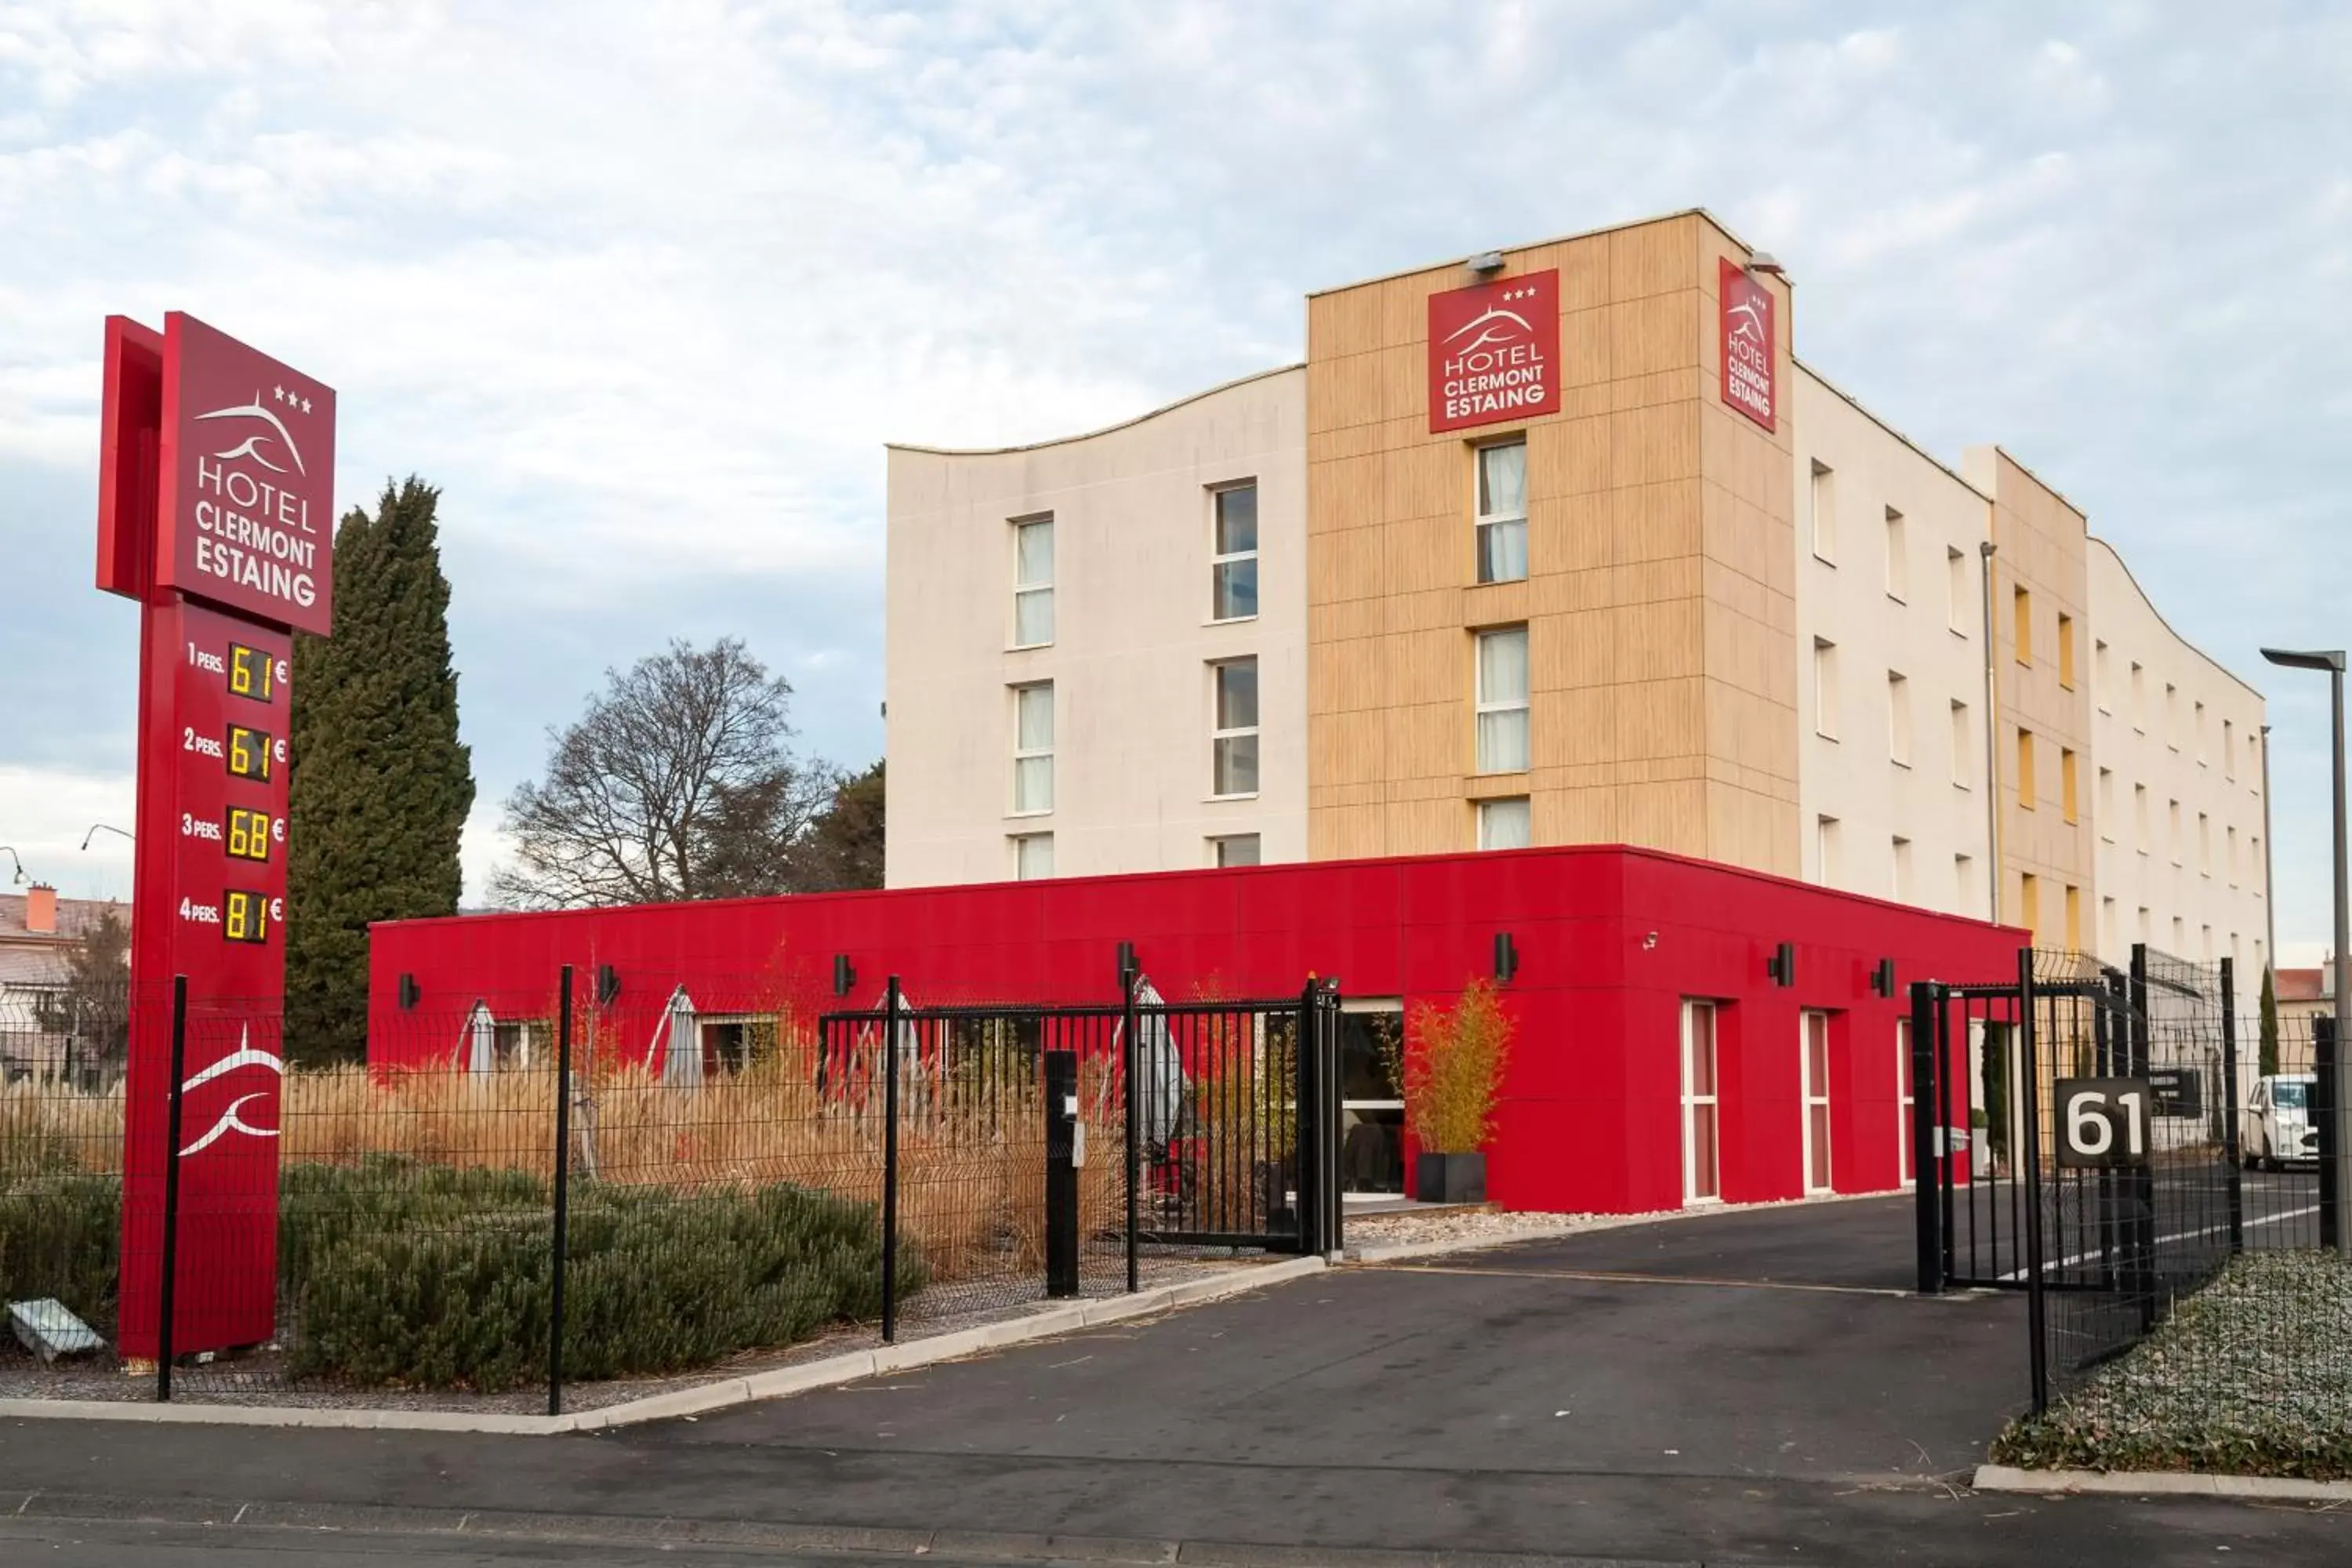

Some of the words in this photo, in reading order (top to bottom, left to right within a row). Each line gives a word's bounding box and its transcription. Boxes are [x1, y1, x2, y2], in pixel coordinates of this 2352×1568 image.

[1444, 343, 1544, 377] HOTEL
[1728, 332, 1769, 376] HOTEL
[1728, 355, 1769, 396] CLERMONT
[1443, 365, 1544, 397] CLERMONT
[1446, 384, 1545, 419] ESTAING
[1729, 375, 1770, 417] ESTAING
[198, 456, 316, 534] HOTEL
[195, 501, 316, 569] CLERMONT
[197, 535, 316, 607] ESTAING
[188, 642, 195, 665] 1
[197, 652, 225, 673] PERS.
[231, 647, 272, 697] 61
[274, 659, 288, 684] €
[184, 727, 194, 750] 2
[195, 736, 223, 757] PERS.
[231, 728, 270, 778] 61
[274, 739, 286, 763] €
[182, 813, 192, 835] 3
[194, 821, 222, 840] PERS.
[230, 810, 269, 858] 68
[272, 818, 285, 842] €
[180, 898, 191, 920] 4
[192, 905, 220, 923] PERS.
[227, 893, 267, 938] 81
[270, 898, 282, 921] €
[2067, 1091, 2143, 1155] 61
